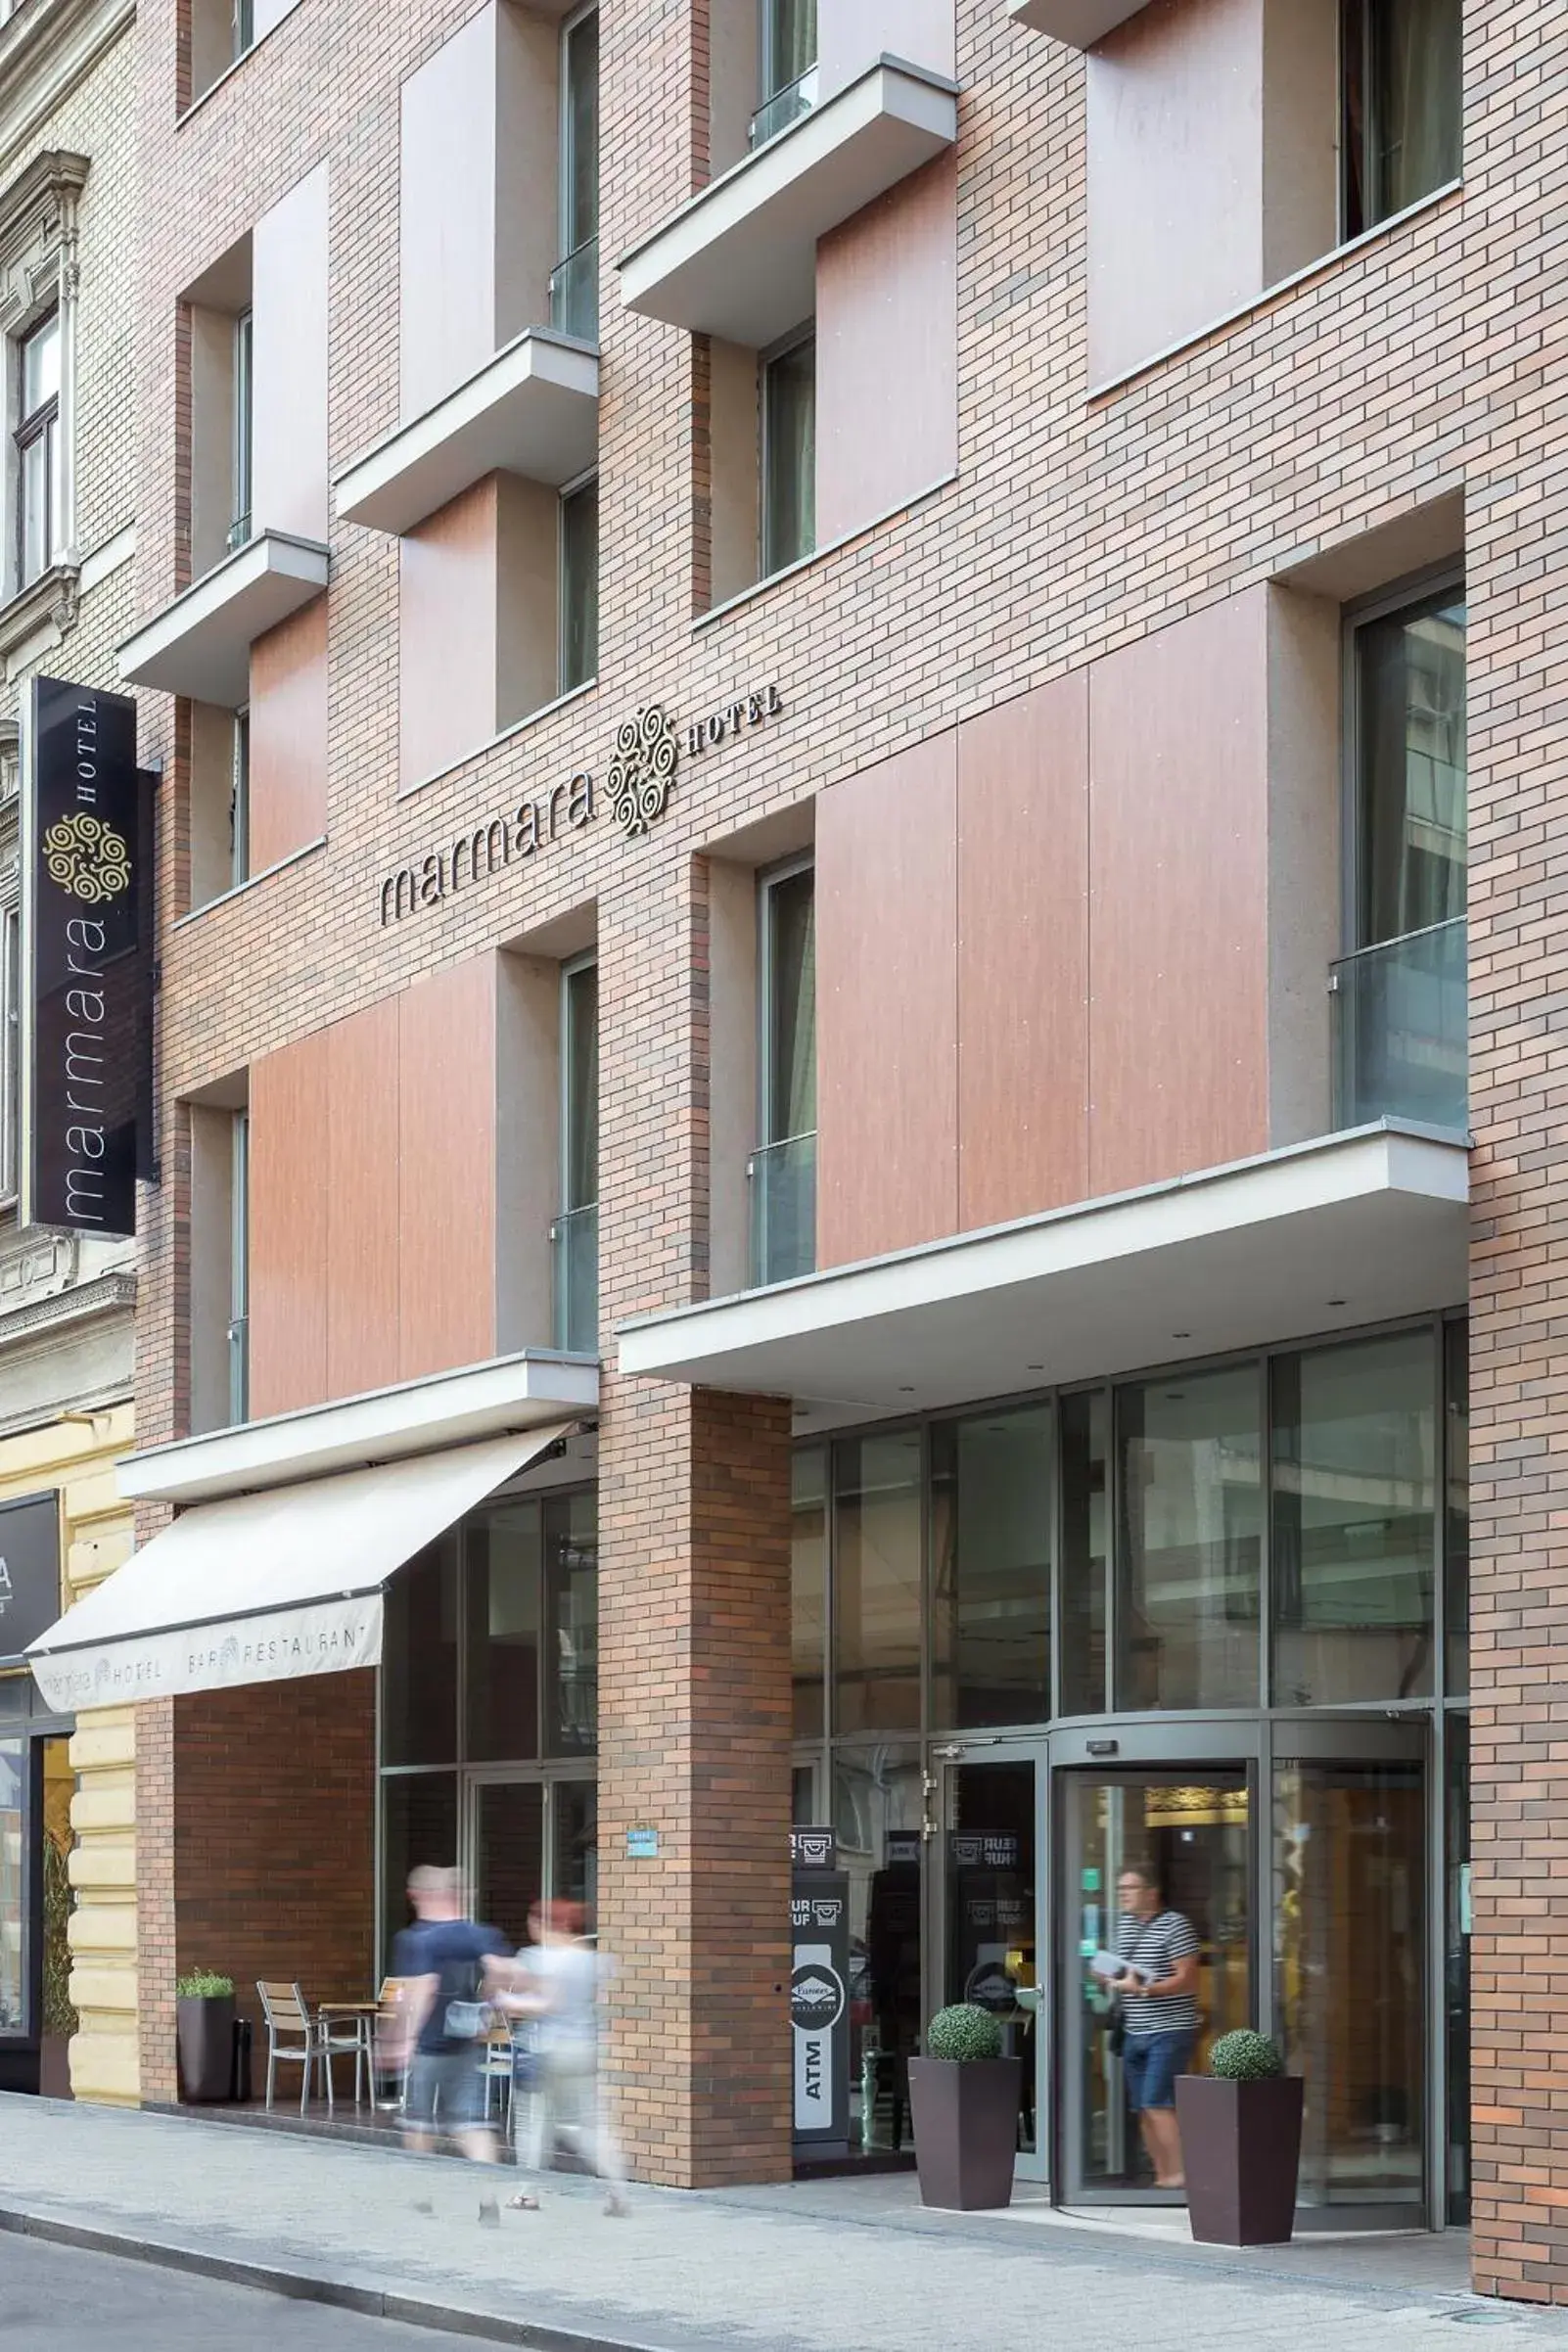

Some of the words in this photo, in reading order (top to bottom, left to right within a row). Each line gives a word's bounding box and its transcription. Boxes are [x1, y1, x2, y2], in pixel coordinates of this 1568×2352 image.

[76, 699, 98, 804] HOTEL
[379, 770, 598, 926] marmara
[686, 686, 784, 756] HOTEL
[65, 916, 106, 1222] marmara
[114, 1660, 161, 1684] HOTEL
[245, 1626, 366, 1663] RESTAURANT
[790, 1914, 810, 1926] UF
[791, 1900, 810, 1913] UR
[806, 2041, 821, 2100] ATM
